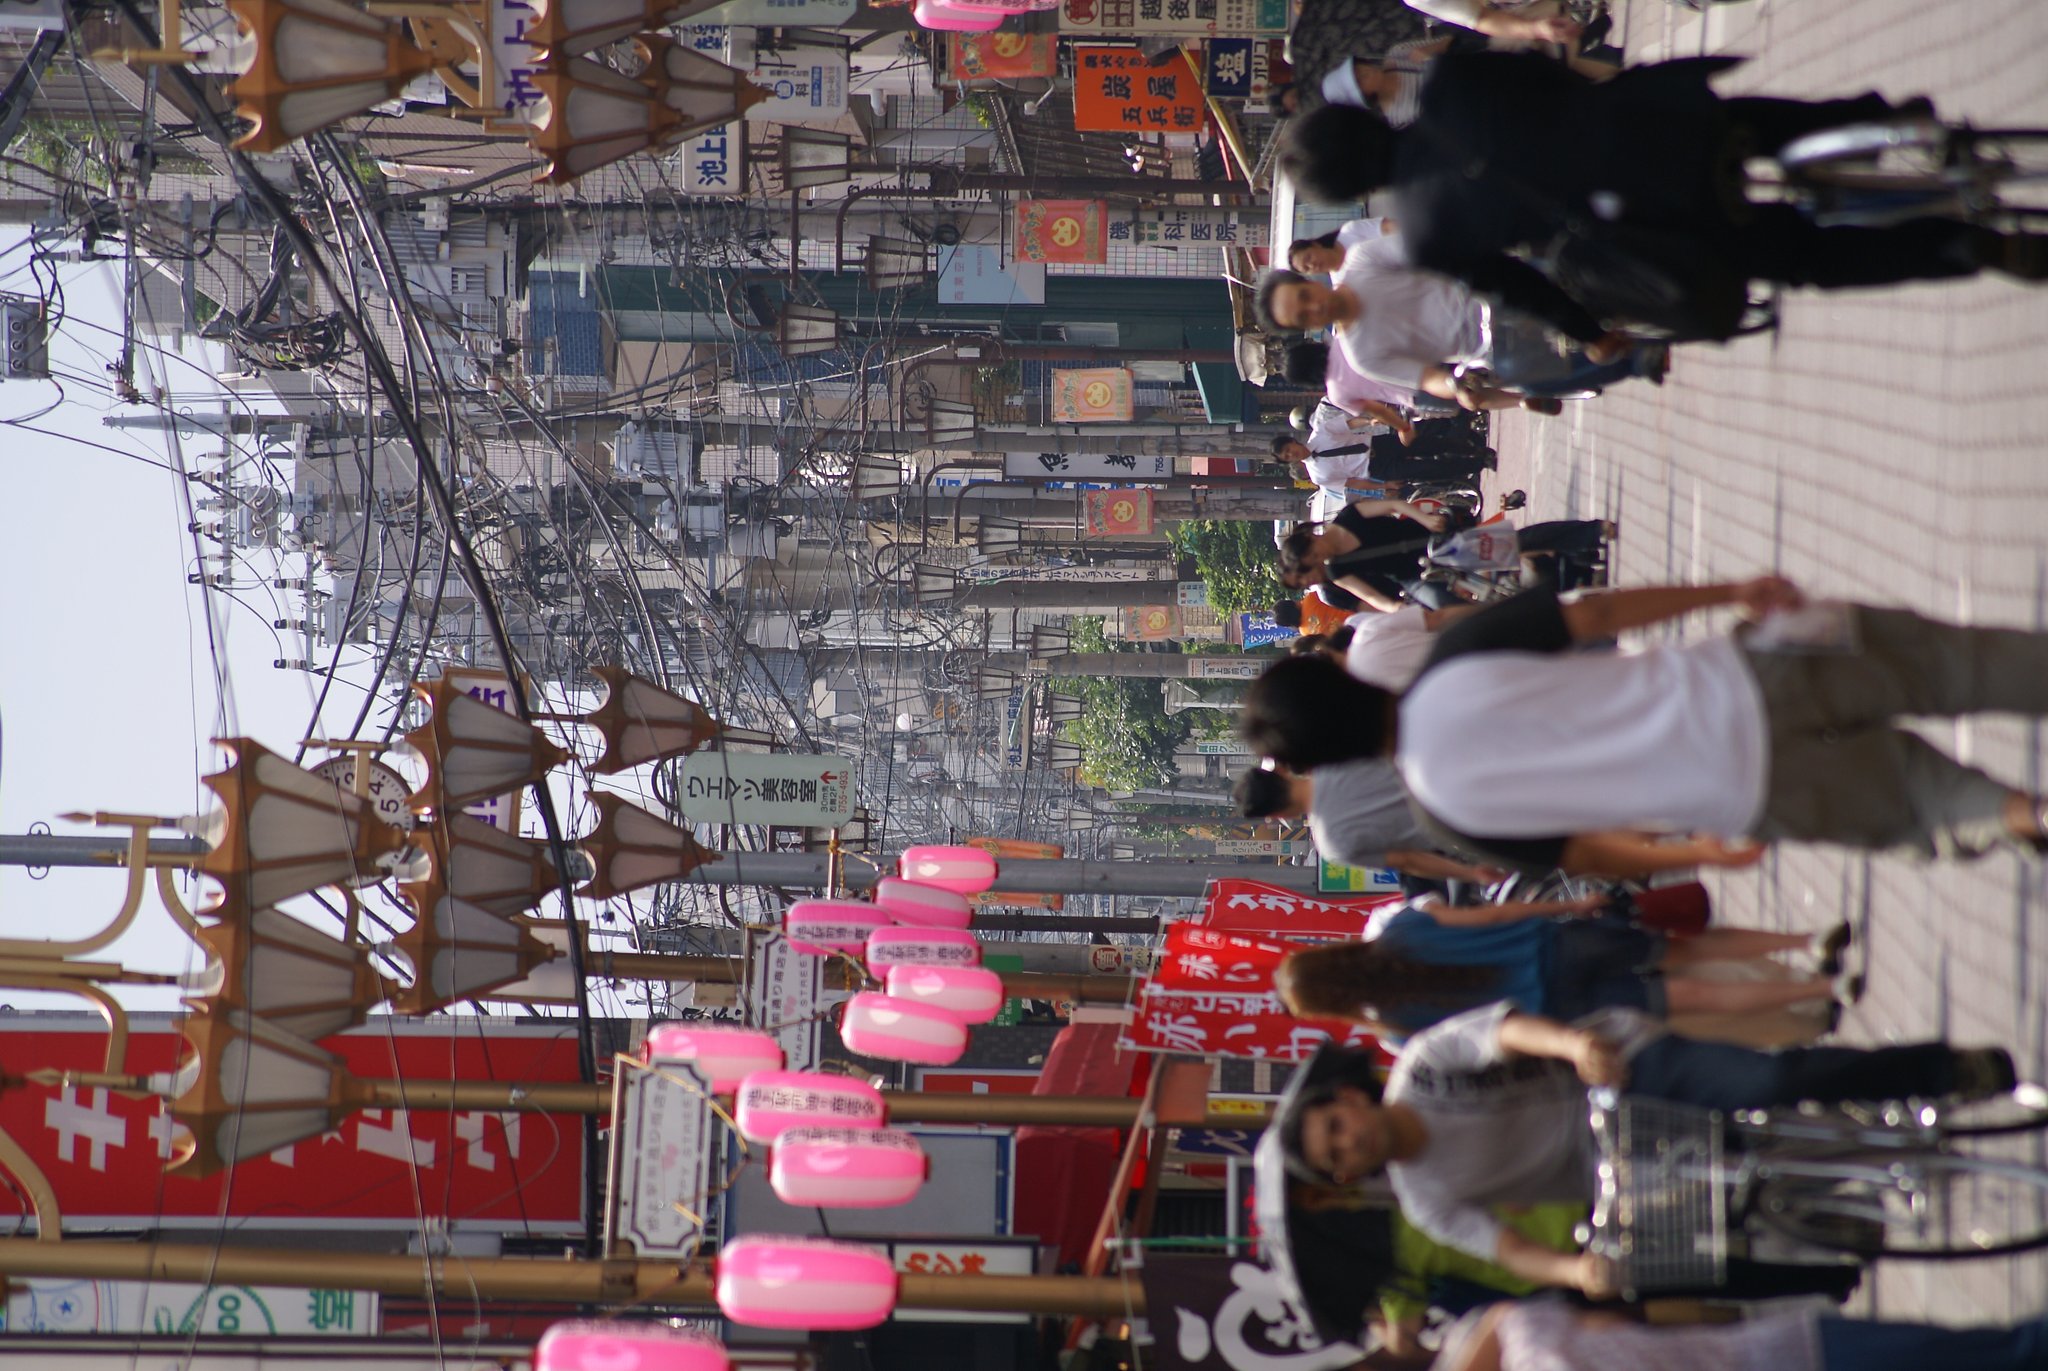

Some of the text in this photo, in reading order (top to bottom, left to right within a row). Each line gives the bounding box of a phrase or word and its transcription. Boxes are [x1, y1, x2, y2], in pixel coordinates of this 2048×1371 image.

[1214, 49, 1247, 85] 塩
[1102, 75, 1177, 100] 炭屋
[1122, 106, 1195, 127] 五兵衛
[368, 781, 383, 795] 4
[686, 776, 817, 803] ウエマツ美容室
[380, 799, 399, 813] 5
[800, 955, 809, 1007] STREE
